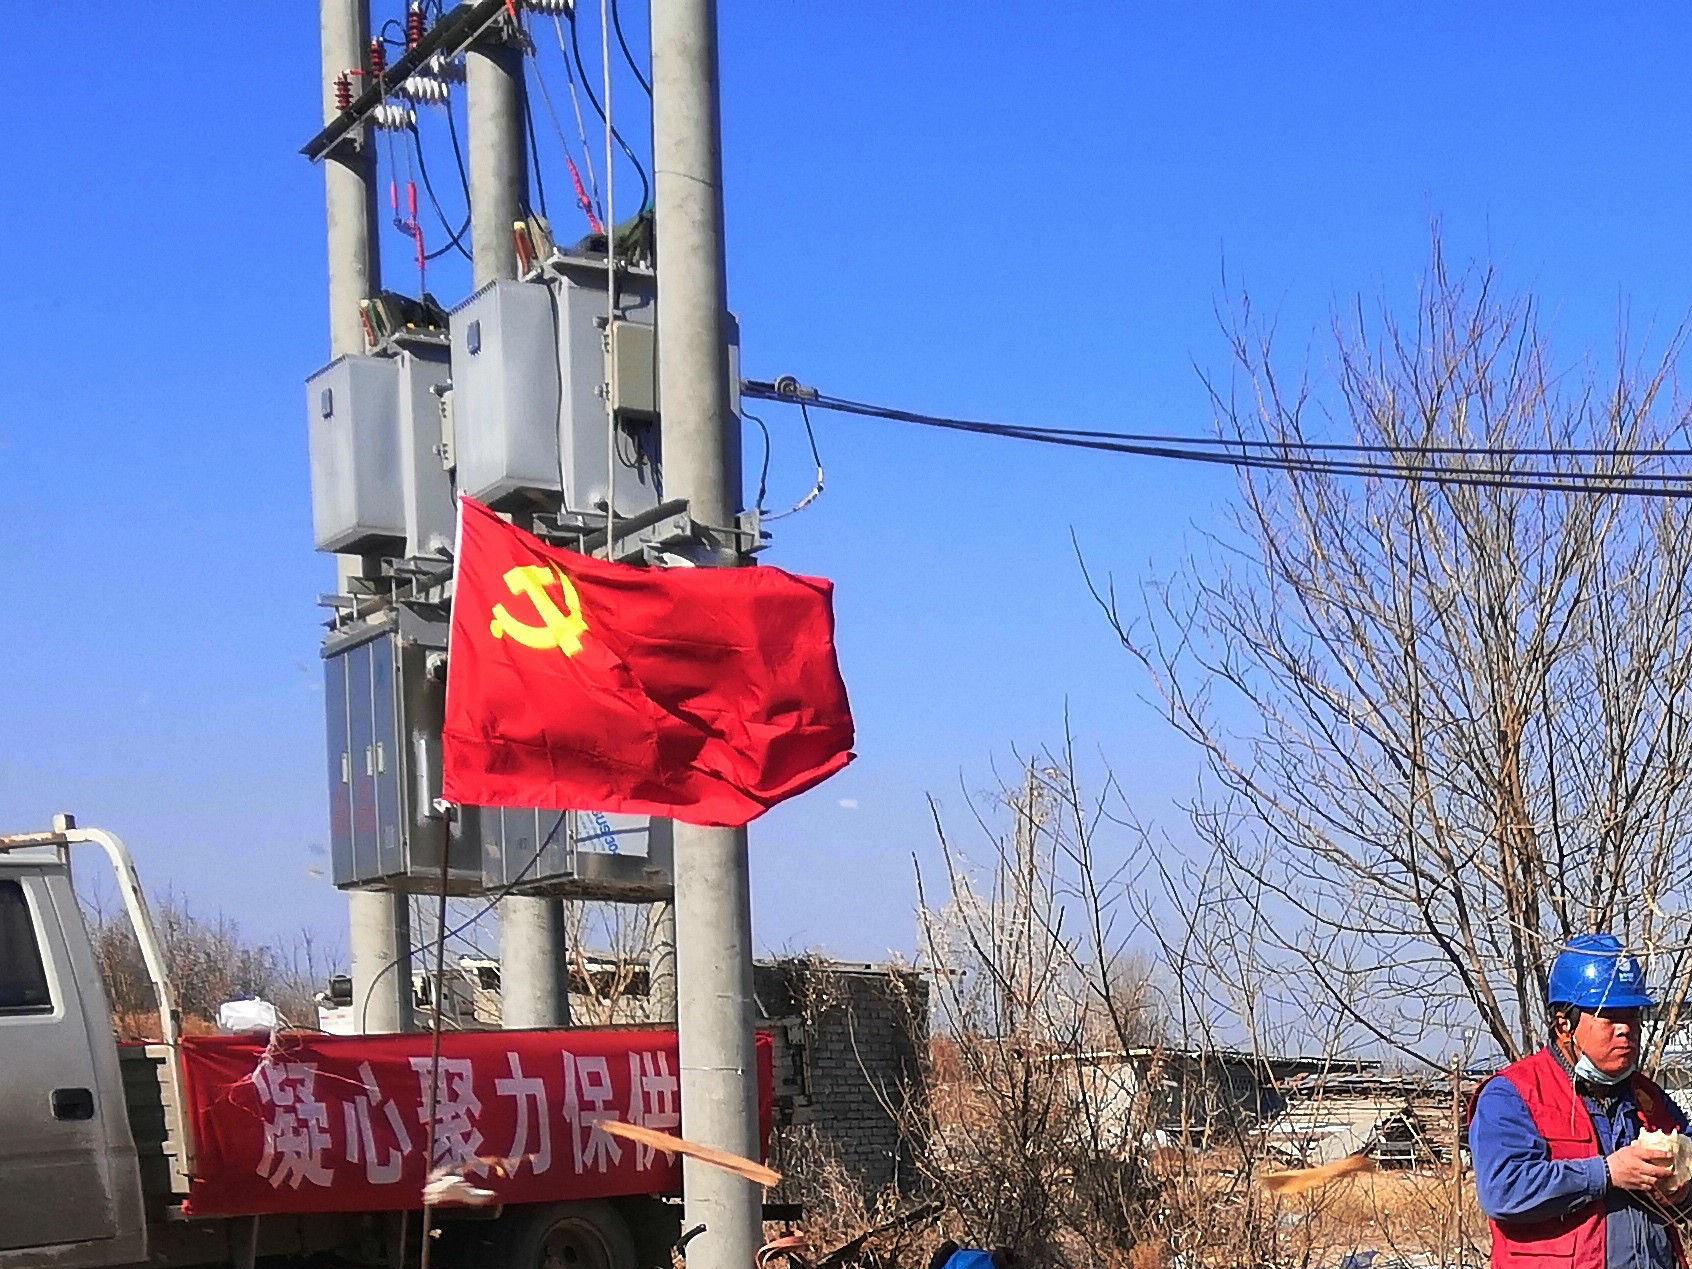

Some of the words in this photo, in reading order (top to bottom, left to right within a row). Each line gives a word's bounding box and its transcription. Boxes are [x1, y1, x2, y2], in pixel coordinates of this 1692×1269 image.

[253, 1049, 680, 1191] 凝心聚力保供
